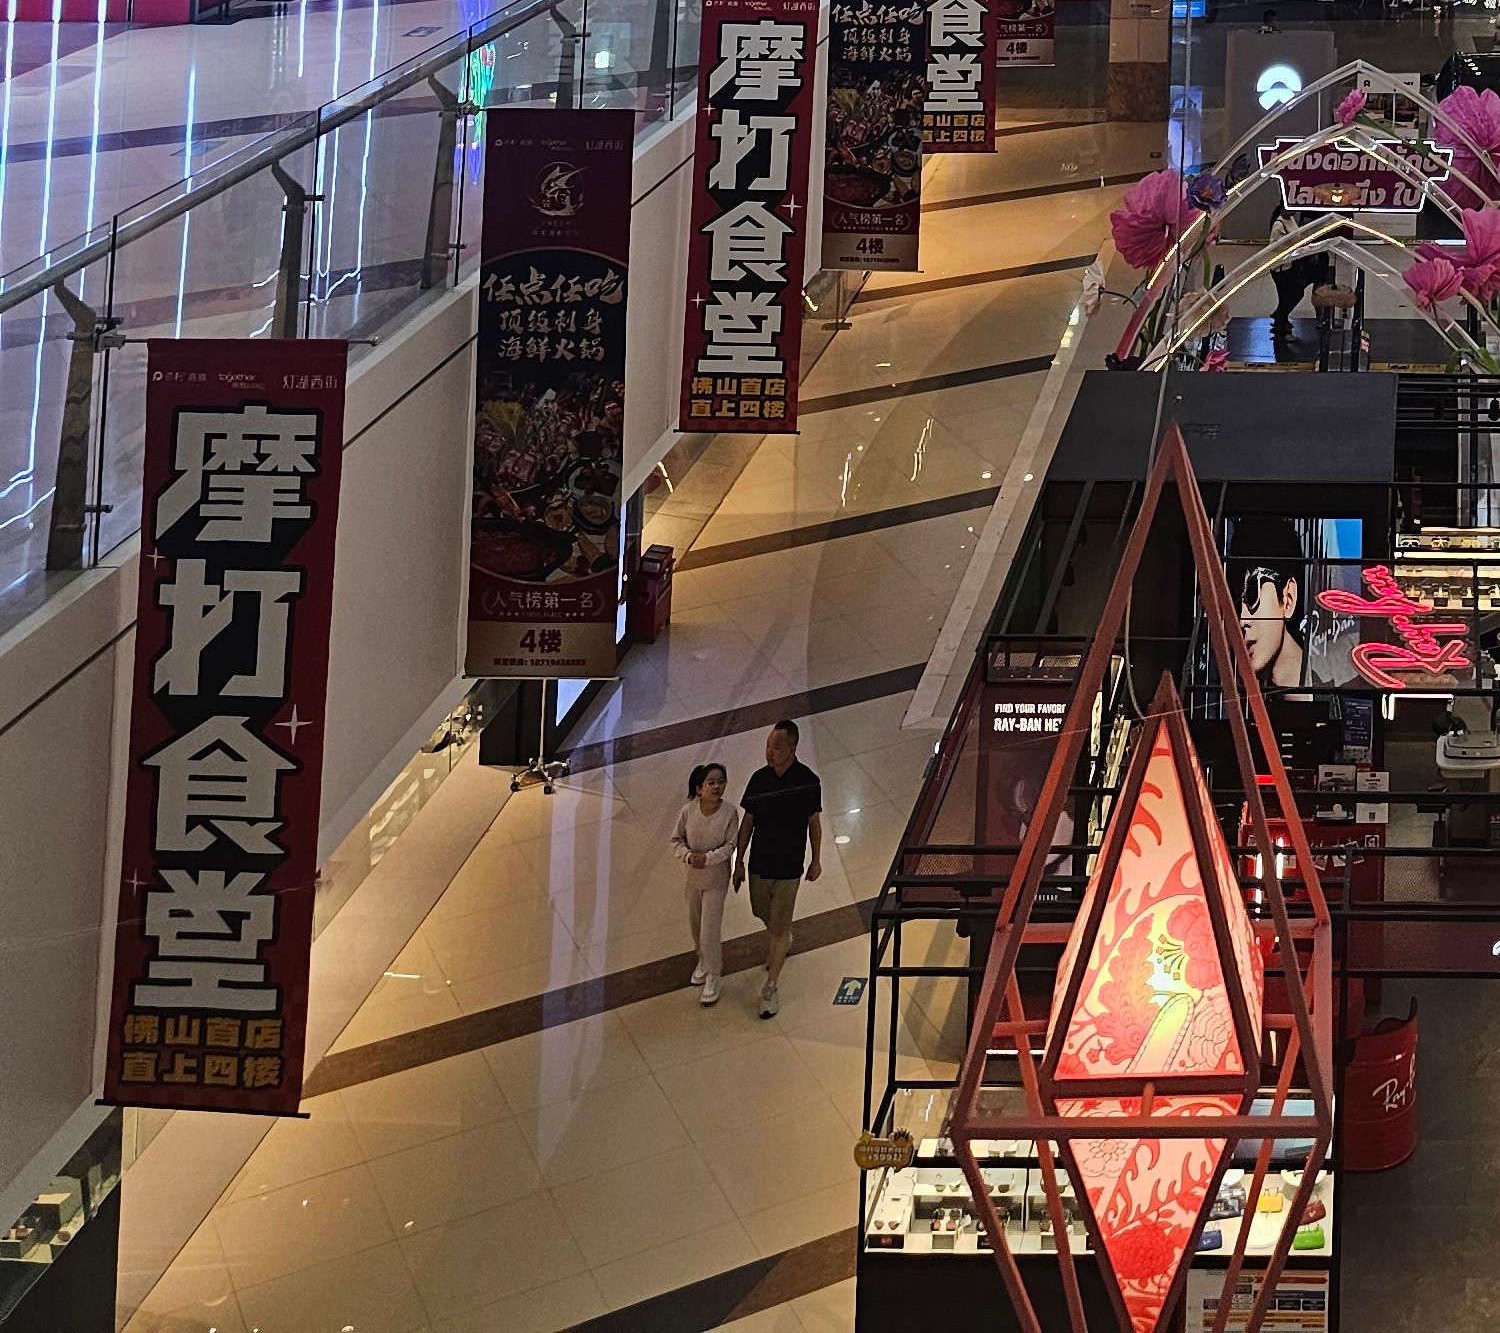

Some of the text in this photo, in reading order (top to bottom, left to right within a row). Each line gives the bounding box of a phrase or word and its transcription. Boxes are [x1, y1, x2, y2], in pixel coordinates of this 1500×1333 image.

[832, 0, 926, 27] 任点任吃
[843, 28, 912, 45] 顶级刺身
[841, 46, 913, 64] 海鲜火锅
[697, 20, 805, 374] 摩打食堂
[855, 237, 885, 255] 4楼
[482, 266, 624, 306] 任点任吃
[500, 308, 604, 334] 顶级刺身
[498, 336, 605, 364] 海鲜火锅
[691, 376, 786, 397] 佛山首店
[690, 399, 785, 419] 直上四楼
[492, 590, 594, 611] 人气榜第一名
[519, 629, 562, 654] 4楼
[134, 405, 317, 1012] 摩打食堂
[993, 717, 1042, 732] RAY-BAN
[123, 1014, 283, 1050] 佛山首店
[121, 1051, 282, 1088] 直上四楼
